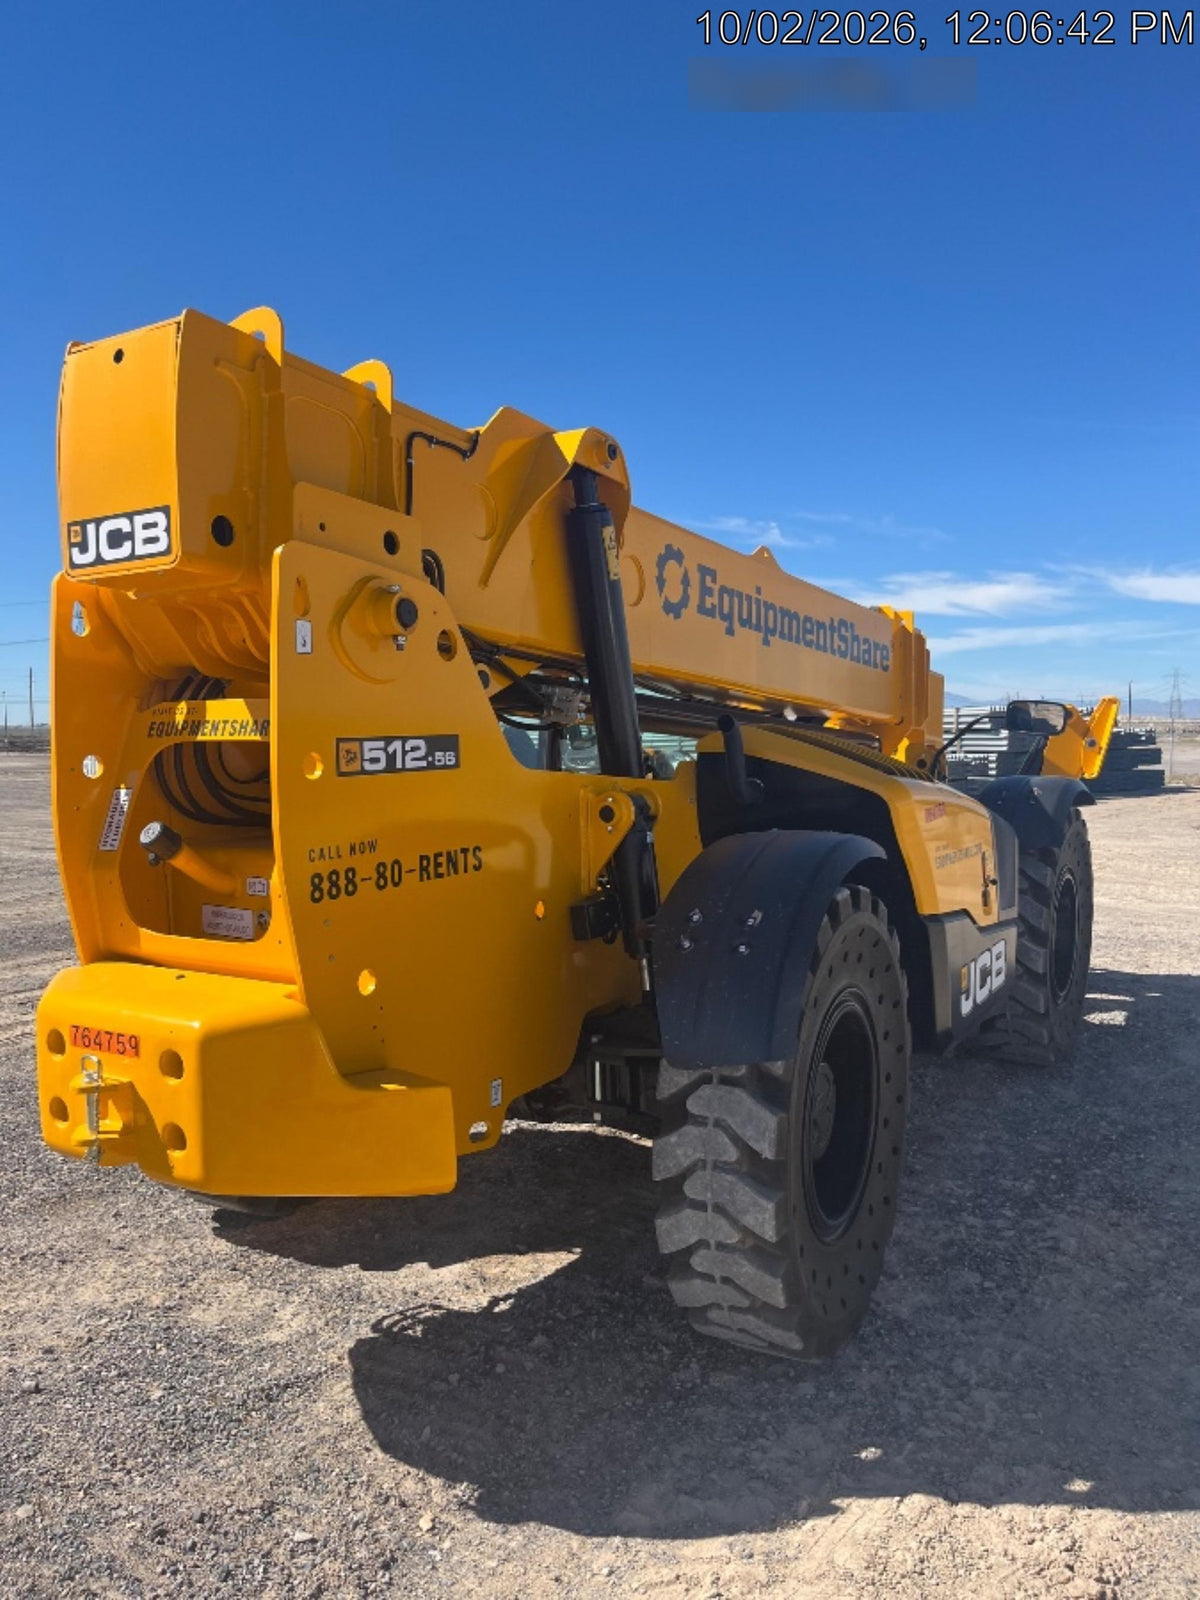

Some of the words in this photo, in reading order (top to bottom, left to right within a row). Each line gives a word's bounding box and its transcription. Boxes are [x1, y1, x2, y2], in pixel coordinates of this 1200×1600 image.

[71, 511, 170, 566] JCB
[696, 562, 891, 673] EquipmentShare
[147, 719, 270, 739] EQUIPMENTSHAR
[308, 846, 343, 863] CALL
[349, 839, 379, 857] NOW
[309, 846, 483, 904] 888-80-RENTS
[961, 939, 1008, 1018] JCB
[71, 1025, 140, 1058] 764759
